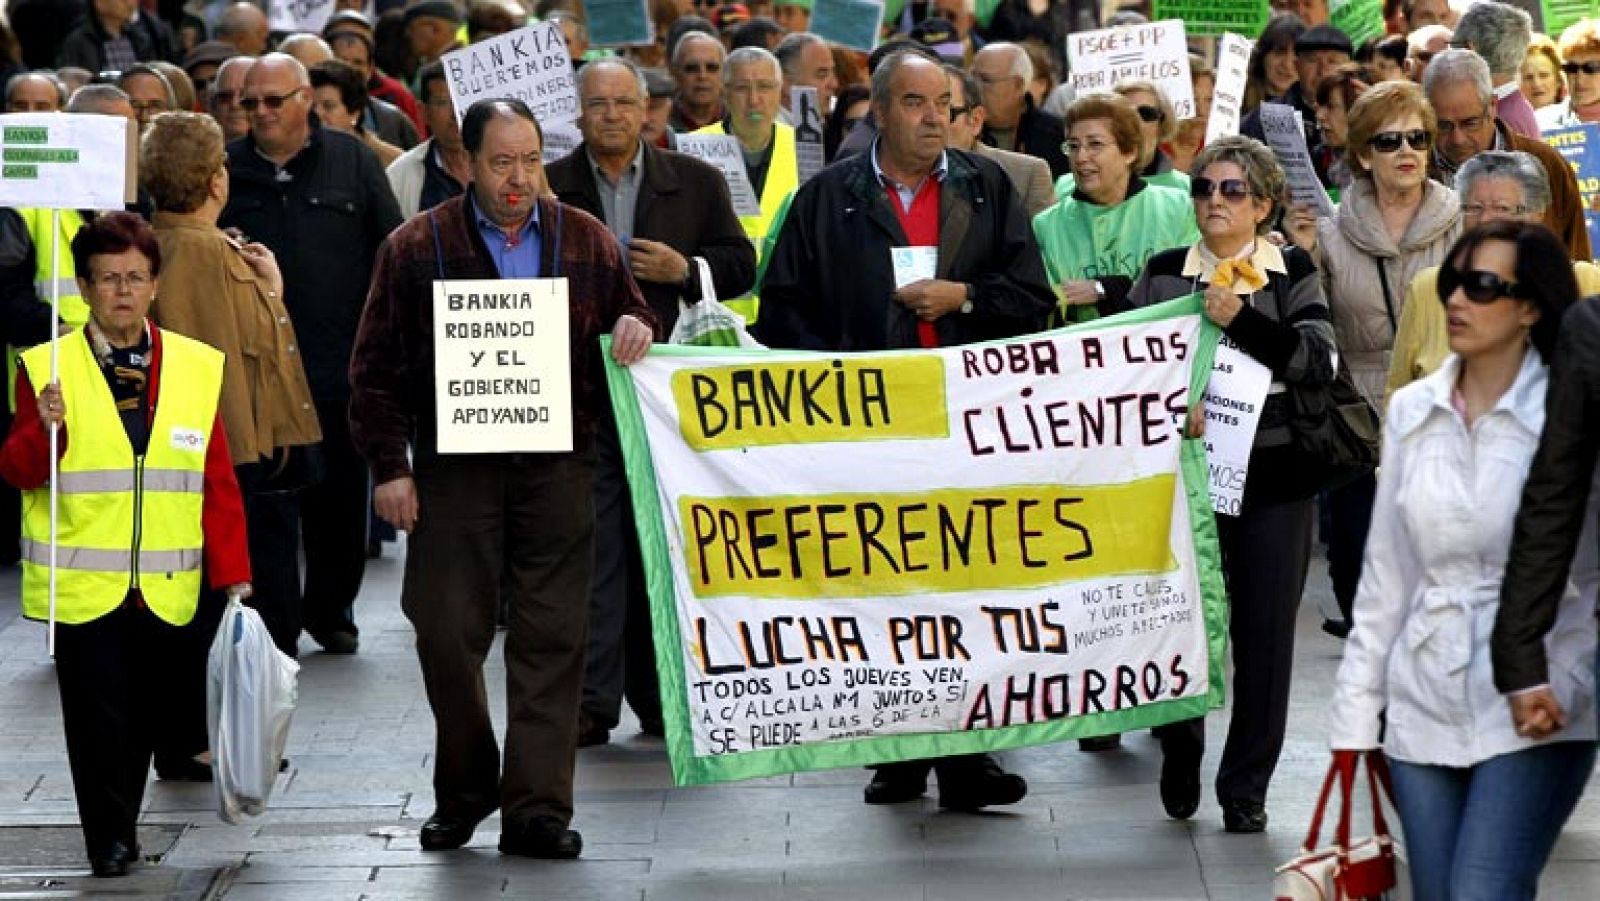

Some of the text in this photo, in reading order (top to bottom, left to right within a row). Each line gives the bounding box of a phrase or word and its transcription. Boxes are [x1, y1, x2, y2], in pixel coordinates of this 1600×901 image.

[448, 25, 563, 82] BANKIA
[447, 292, 532, 311] BANKIA
[445, 321, 534, 339] ROBANDO
[470, 350, 526, 367] Y EL
[962, 340, 1060, 378] ROBA
[1081, 338, 1104, 368] A
[1122, 332, 1188, 363] LOS
[447, 377, 541, 397] GOBIERNO
[691, 359, 890, 438] BANKIA
[451, 406, 549, 424] APOYANDO
[963, 387, 1188, 455] CLIENTES
[691, 498, 1094, 585] PREFERENTES
[1081, 588, 1103, 606] NO
[1105, 583, 1124, 600] TE
[1088, 609, 1097, 623] Y
[695, 600, 1069, 675] LUCHA POR TUS
[1073, 622, 1124, 649] MUCHOS
[693, 677, 773, 703] TODOS
[786, 667, 831, 691] LOS
[843, 667, 911, 689] JUEVES
[964, 654, 1190, 730] AHORROS
[703, 708, 714, 724] A
[720, 700, 740, 723] C/
[744, 693, 824, 719] ALCALA
[872, 688, 937, 710] JUNTOS
[709, 728, 739, 755] SE
[749, 723, 803, 750] PUEDE
[828, 714, 861, 728] LAS
[872, 710, 884, 729] 6
[892, 708, 911, 723] DE
[920, 704, 941, 719] LA
